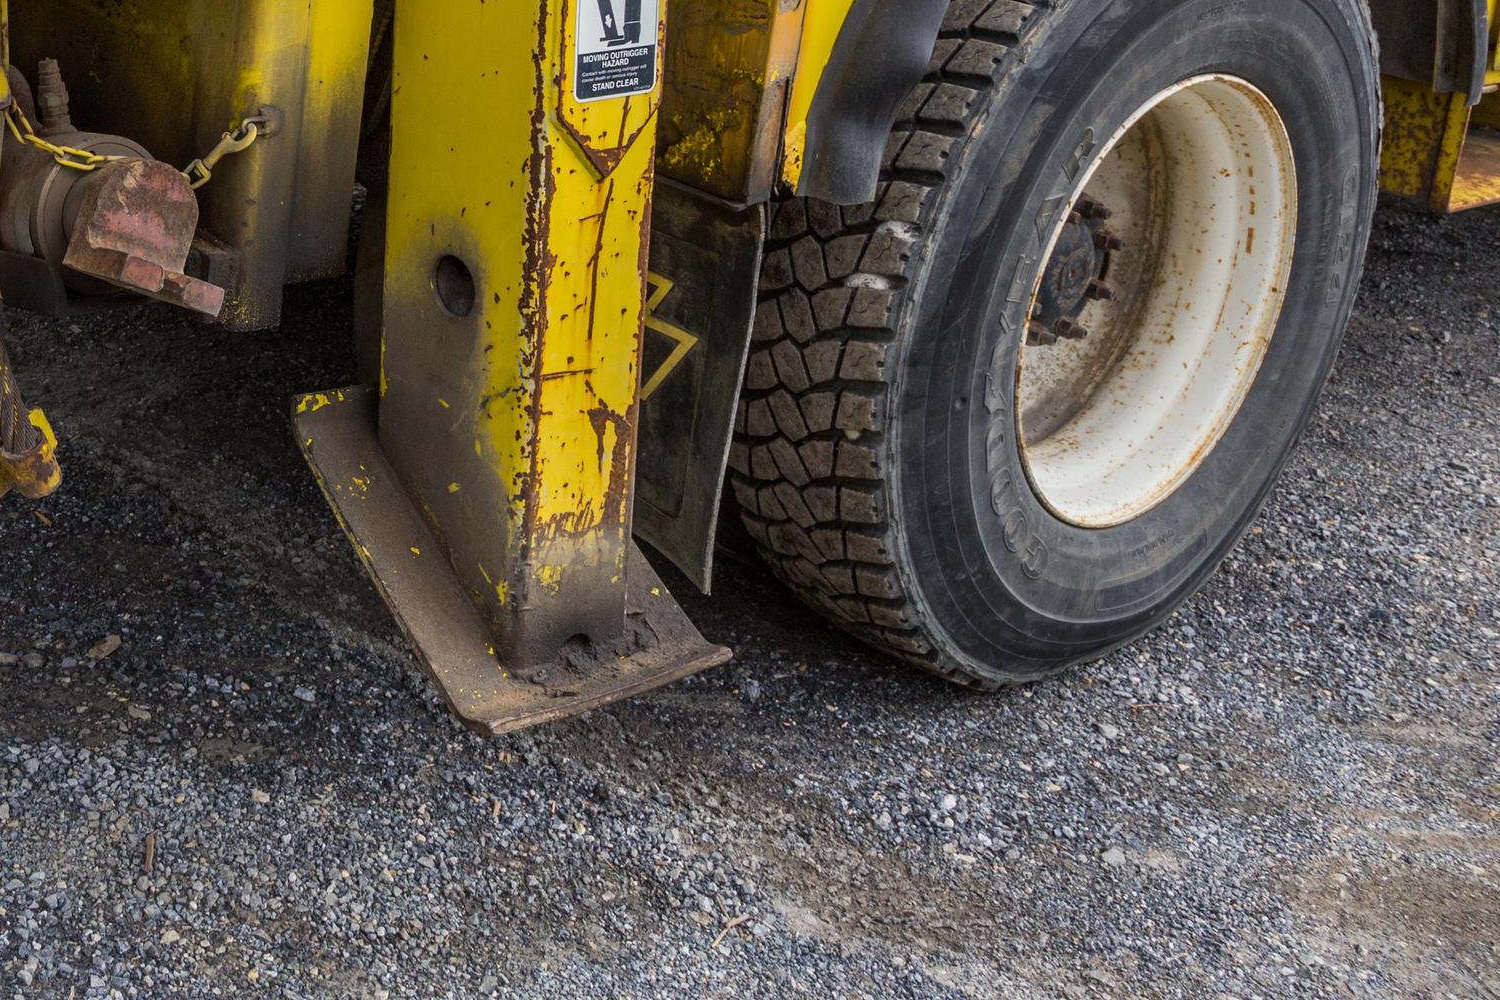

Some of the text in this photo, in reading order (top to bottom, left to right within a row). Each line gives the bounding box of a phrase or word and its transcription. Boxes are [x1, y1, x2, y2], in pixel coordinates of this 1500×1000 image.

[583, 48, 648, 63] MOVING OUTRIGGER
[602, 58, 629, 68] HAZARD
[592, 81, 615, 91] STAND
[616, 78, 639, 88] CLEAR
[983, 126, 1098, 580] GOODYEAR
